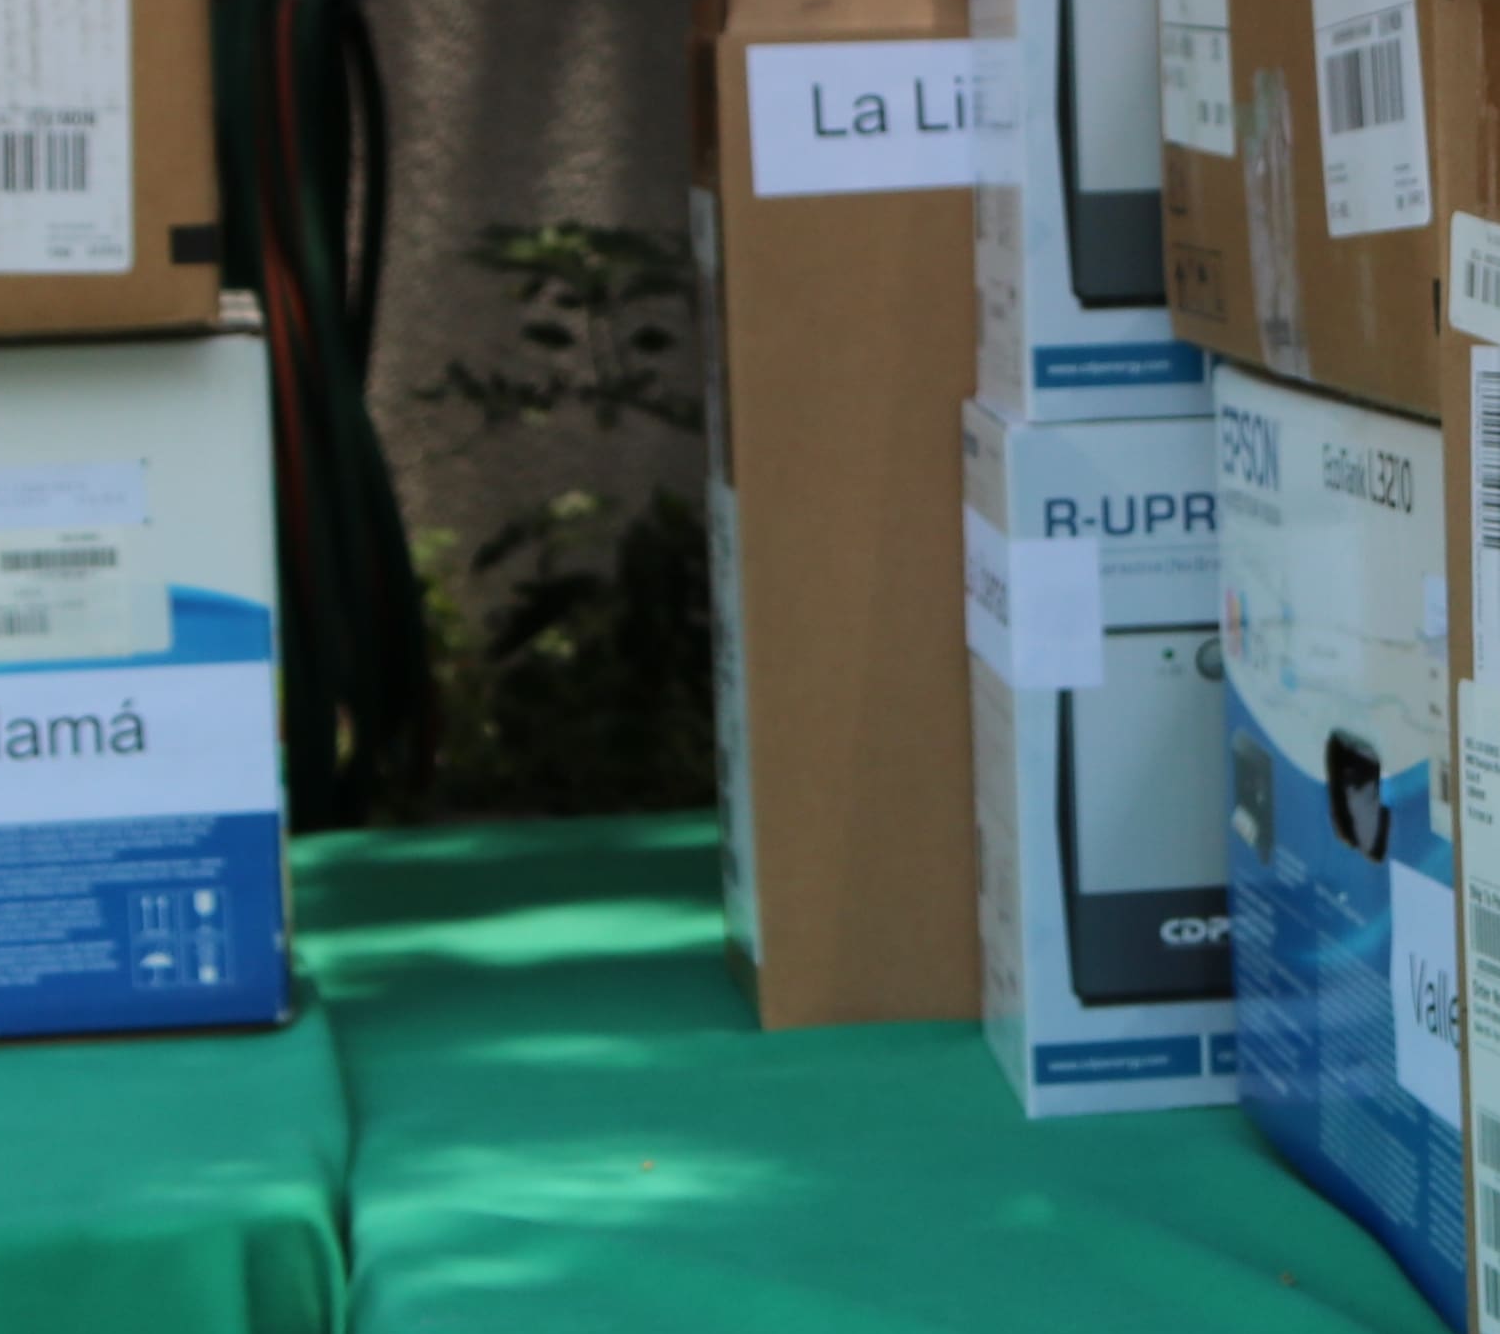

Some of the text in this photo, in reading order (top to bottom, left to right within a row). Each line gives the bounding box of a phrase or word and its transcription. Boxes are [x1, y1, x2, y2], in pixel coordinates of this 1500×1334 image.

[812, 81, 888, 138] La
[1222, 404, 1281, 492] EPSON
[1368, 447, 1413, 514] L3210
